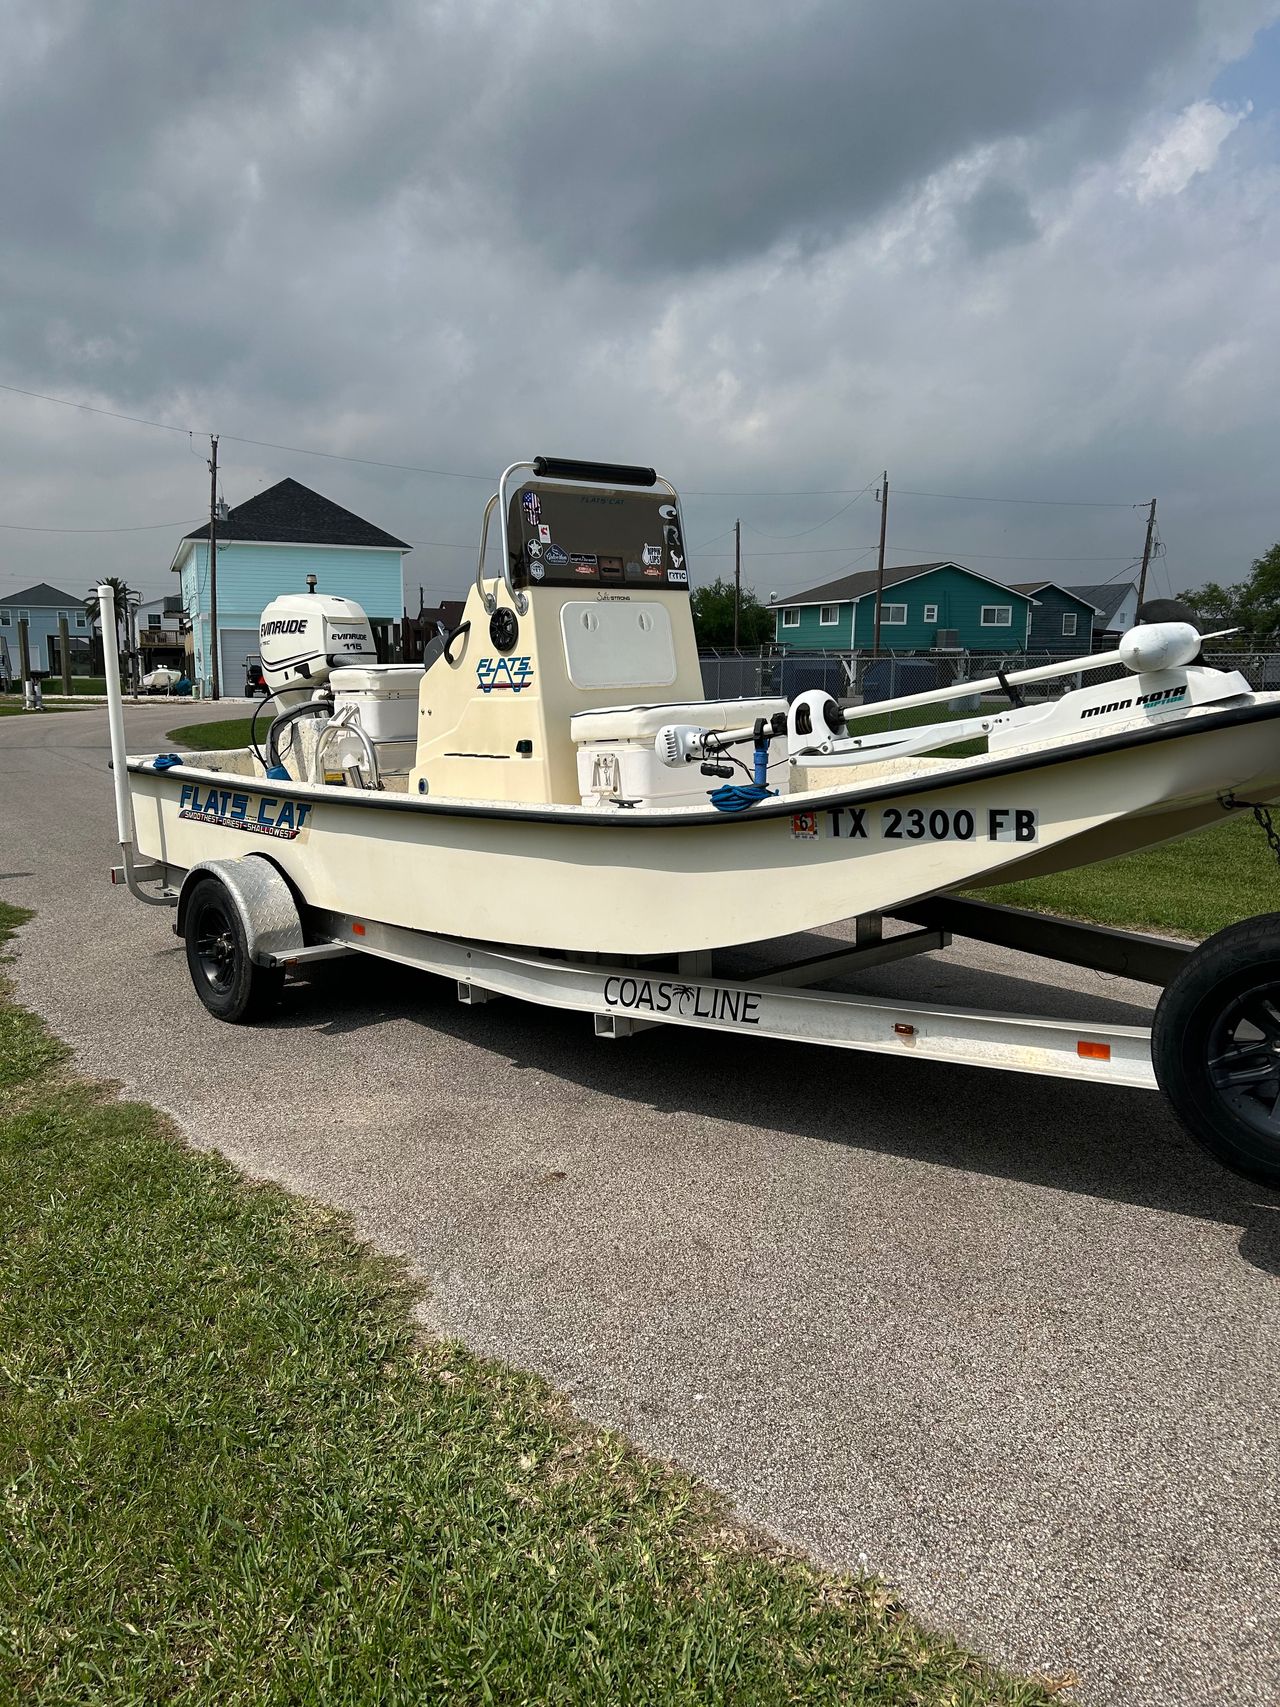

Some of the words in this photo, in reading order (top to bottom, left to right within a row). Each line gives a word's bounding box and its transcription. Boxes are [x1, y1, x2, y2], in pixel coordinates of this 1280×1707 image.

[260, 619, 308, 638] EVINRUDE
[331, 633, 368, 641] EVINRUDE
[343, 643, 363, 651] 115
[476, 656, 531, 673] FLATS
[1080, 698, 1133, 719] MINN
[1135, 684, 1188, 706] KOTA
[1143, 695, 1186, 709] RIPTIDE
[179, 784, 250, 821] FLATS
[257, 797, 312, 830] CAT
[799, 813, 808, 831] 6
[827, 808, 868, 838] TX
[883, 808, 974, 841] 2300
[989, 809, 1036, 842] FB
